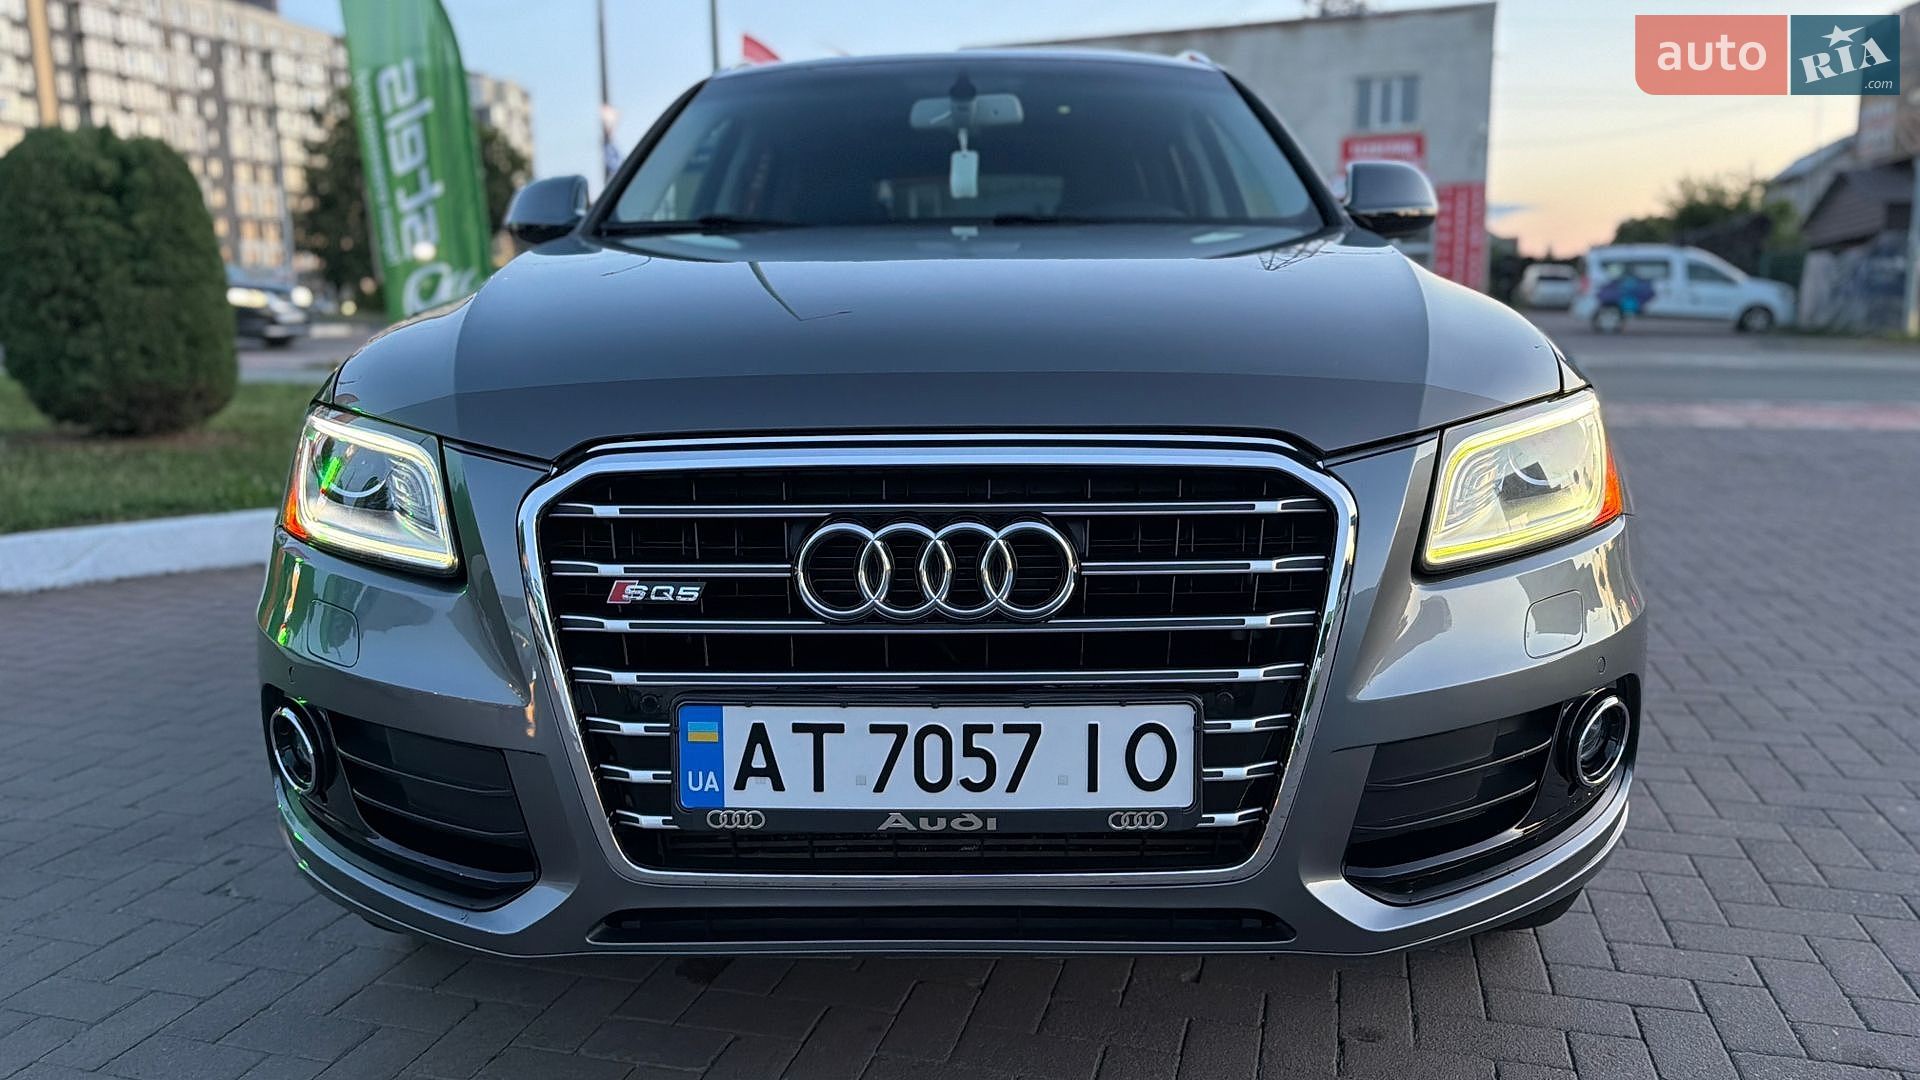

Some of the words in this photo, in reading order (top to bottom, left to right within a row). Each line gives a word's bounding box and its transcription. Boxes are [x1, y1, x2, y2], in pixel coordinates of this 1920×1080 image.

[621, 584, 701, 601] SQ5
[733, 722, 845, 793] AT
[869, 723, 1042, 794] 7057
[1087, 722, 1178, 793] IO
[688, 771, 720, 792] UA
[877, 812, 998, 832] Audi
